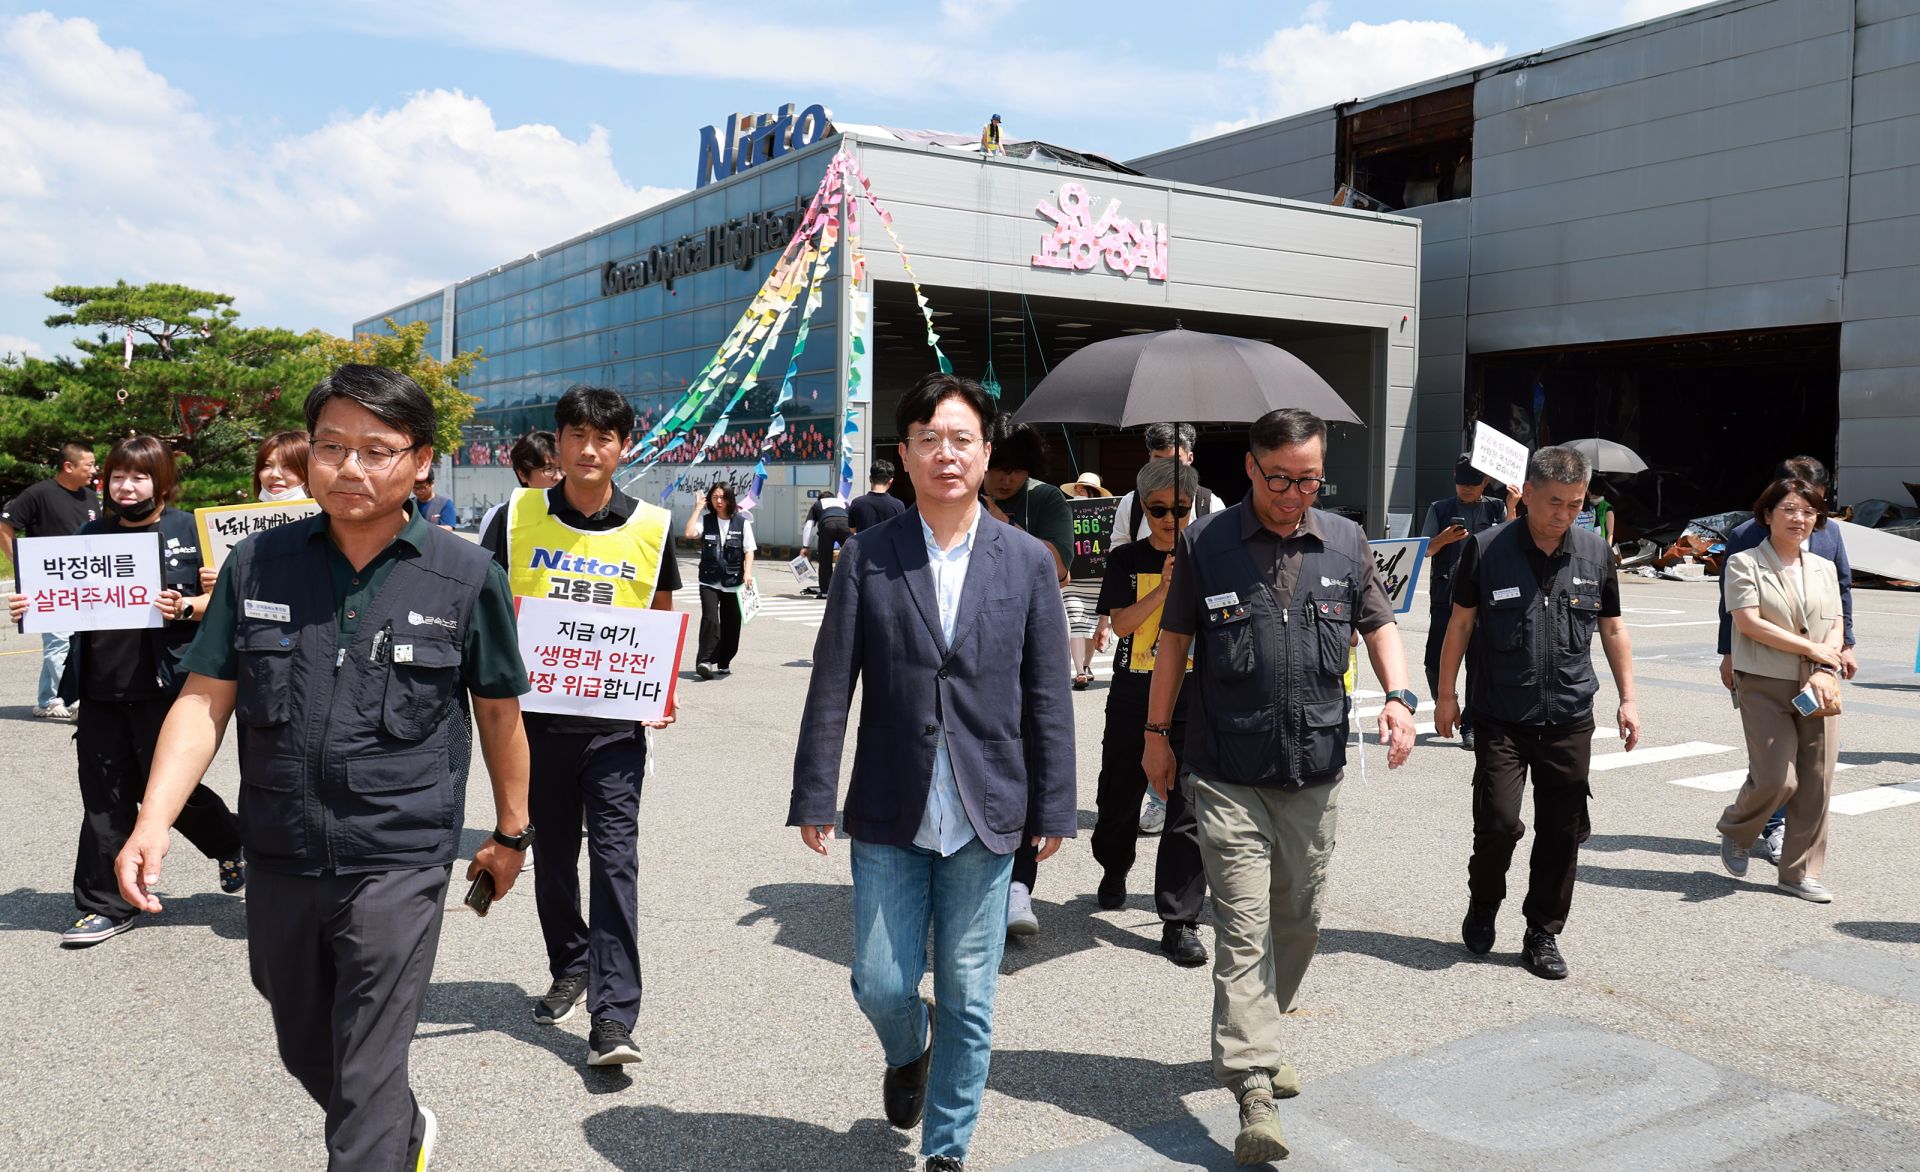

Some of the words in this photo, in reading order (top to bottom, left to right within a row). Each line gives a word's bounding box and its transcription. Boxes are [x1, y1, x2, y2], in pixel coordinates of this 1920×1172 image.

[696, 103, 833, 189] Nitto
[600, 261, 648, 297] Korea
[647, 226, 714, 291] Optical
[215, 515, 250, 536] 노동자
[1073, 518, 1100, 535] 566
[1074, 540, 1101, 556] 164
[43, 554, 136, 581] 박정혜를
[531, 548, 636, 580] Nitto는
[34, 585, 150, 613] 살려주세요
[548, 577, 614, 605] 고용을
[557, 621, 595, 642] 지금
[600, 625, 640, 649] 여기,
[562, 675, 661, 702] 위급합니다
